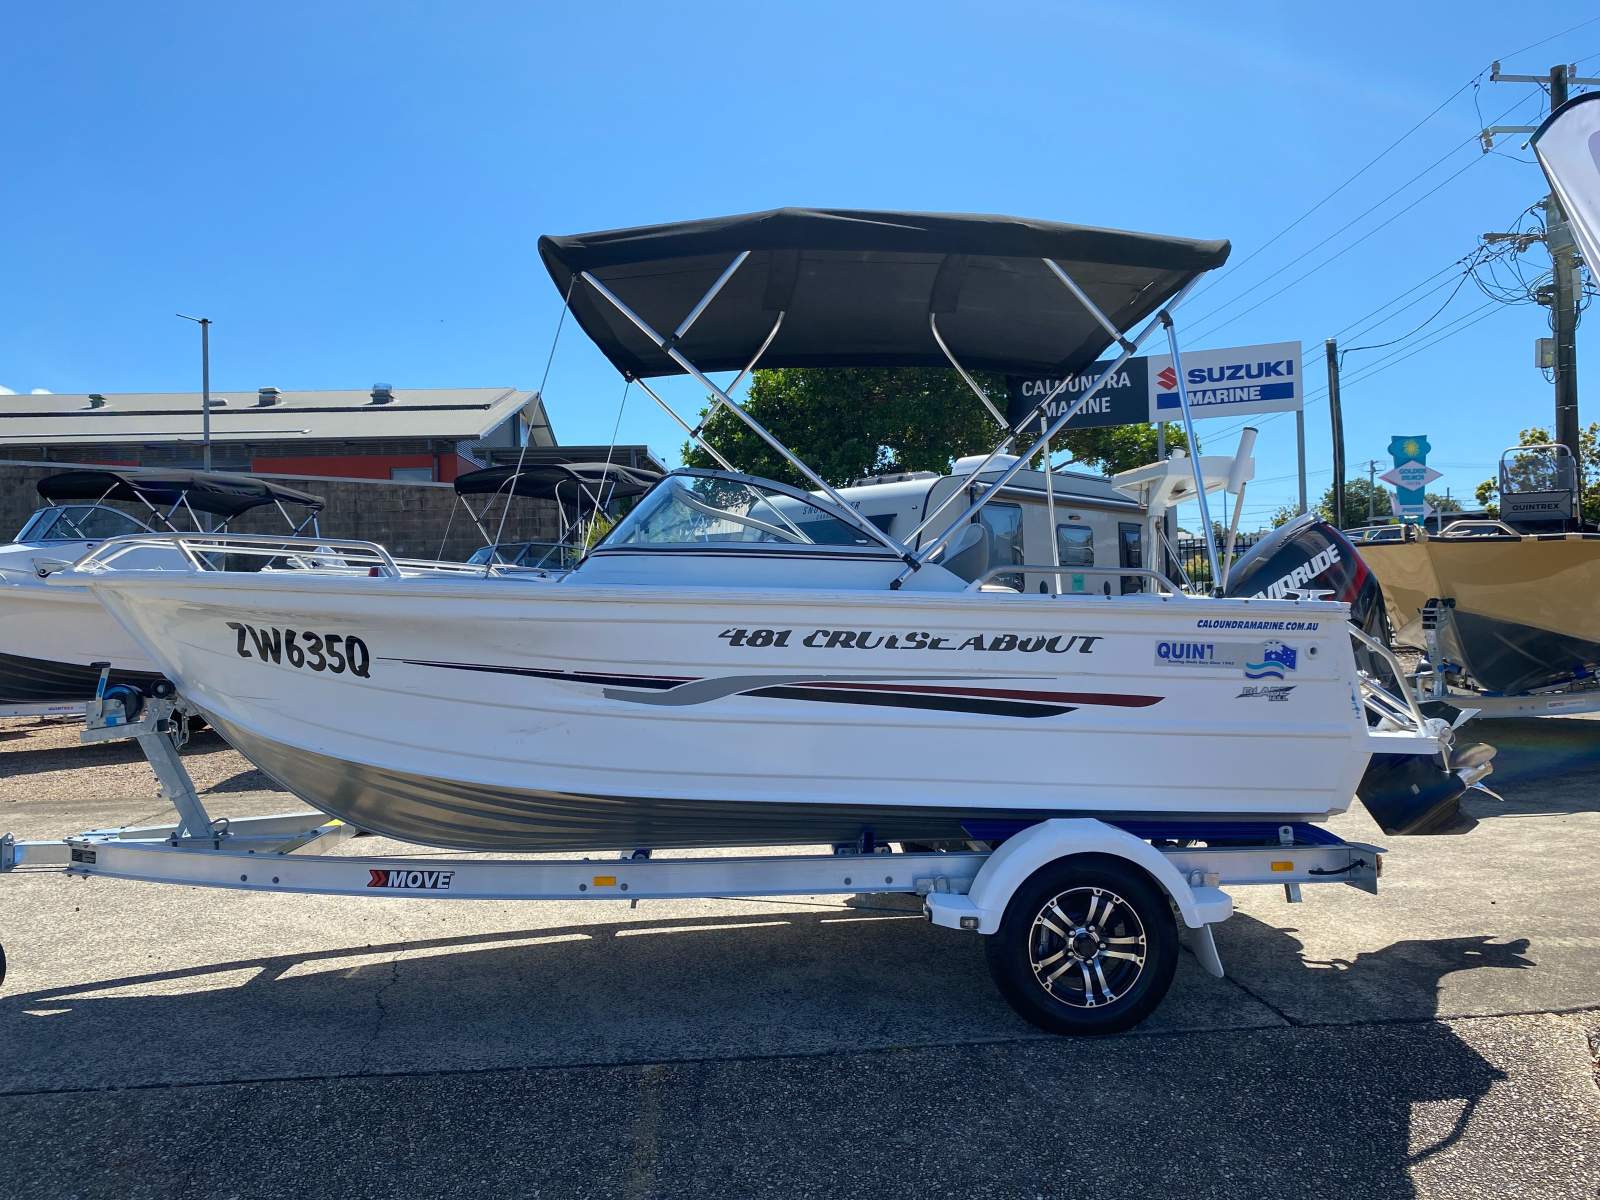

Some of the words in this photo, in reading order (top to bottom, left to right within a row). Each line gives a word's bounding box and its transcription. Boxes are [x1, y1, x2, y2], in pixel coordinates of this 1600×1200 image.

[1187, 359, 1294, 384] SUZUKI
[1187, 386, 1262, 406] MARINE
[1511, 502, 1561, 511] QUINTREX
[1249, 543, 1341, 599] VINRUDE
[1196, 619, 1319, 632] CALOUNDRAMARINE.COM.AU
[717, 628, 792, 647] 481
[225, 621, 371, 679] ZW635Q
[387, 870, 452, 889] MOVE
